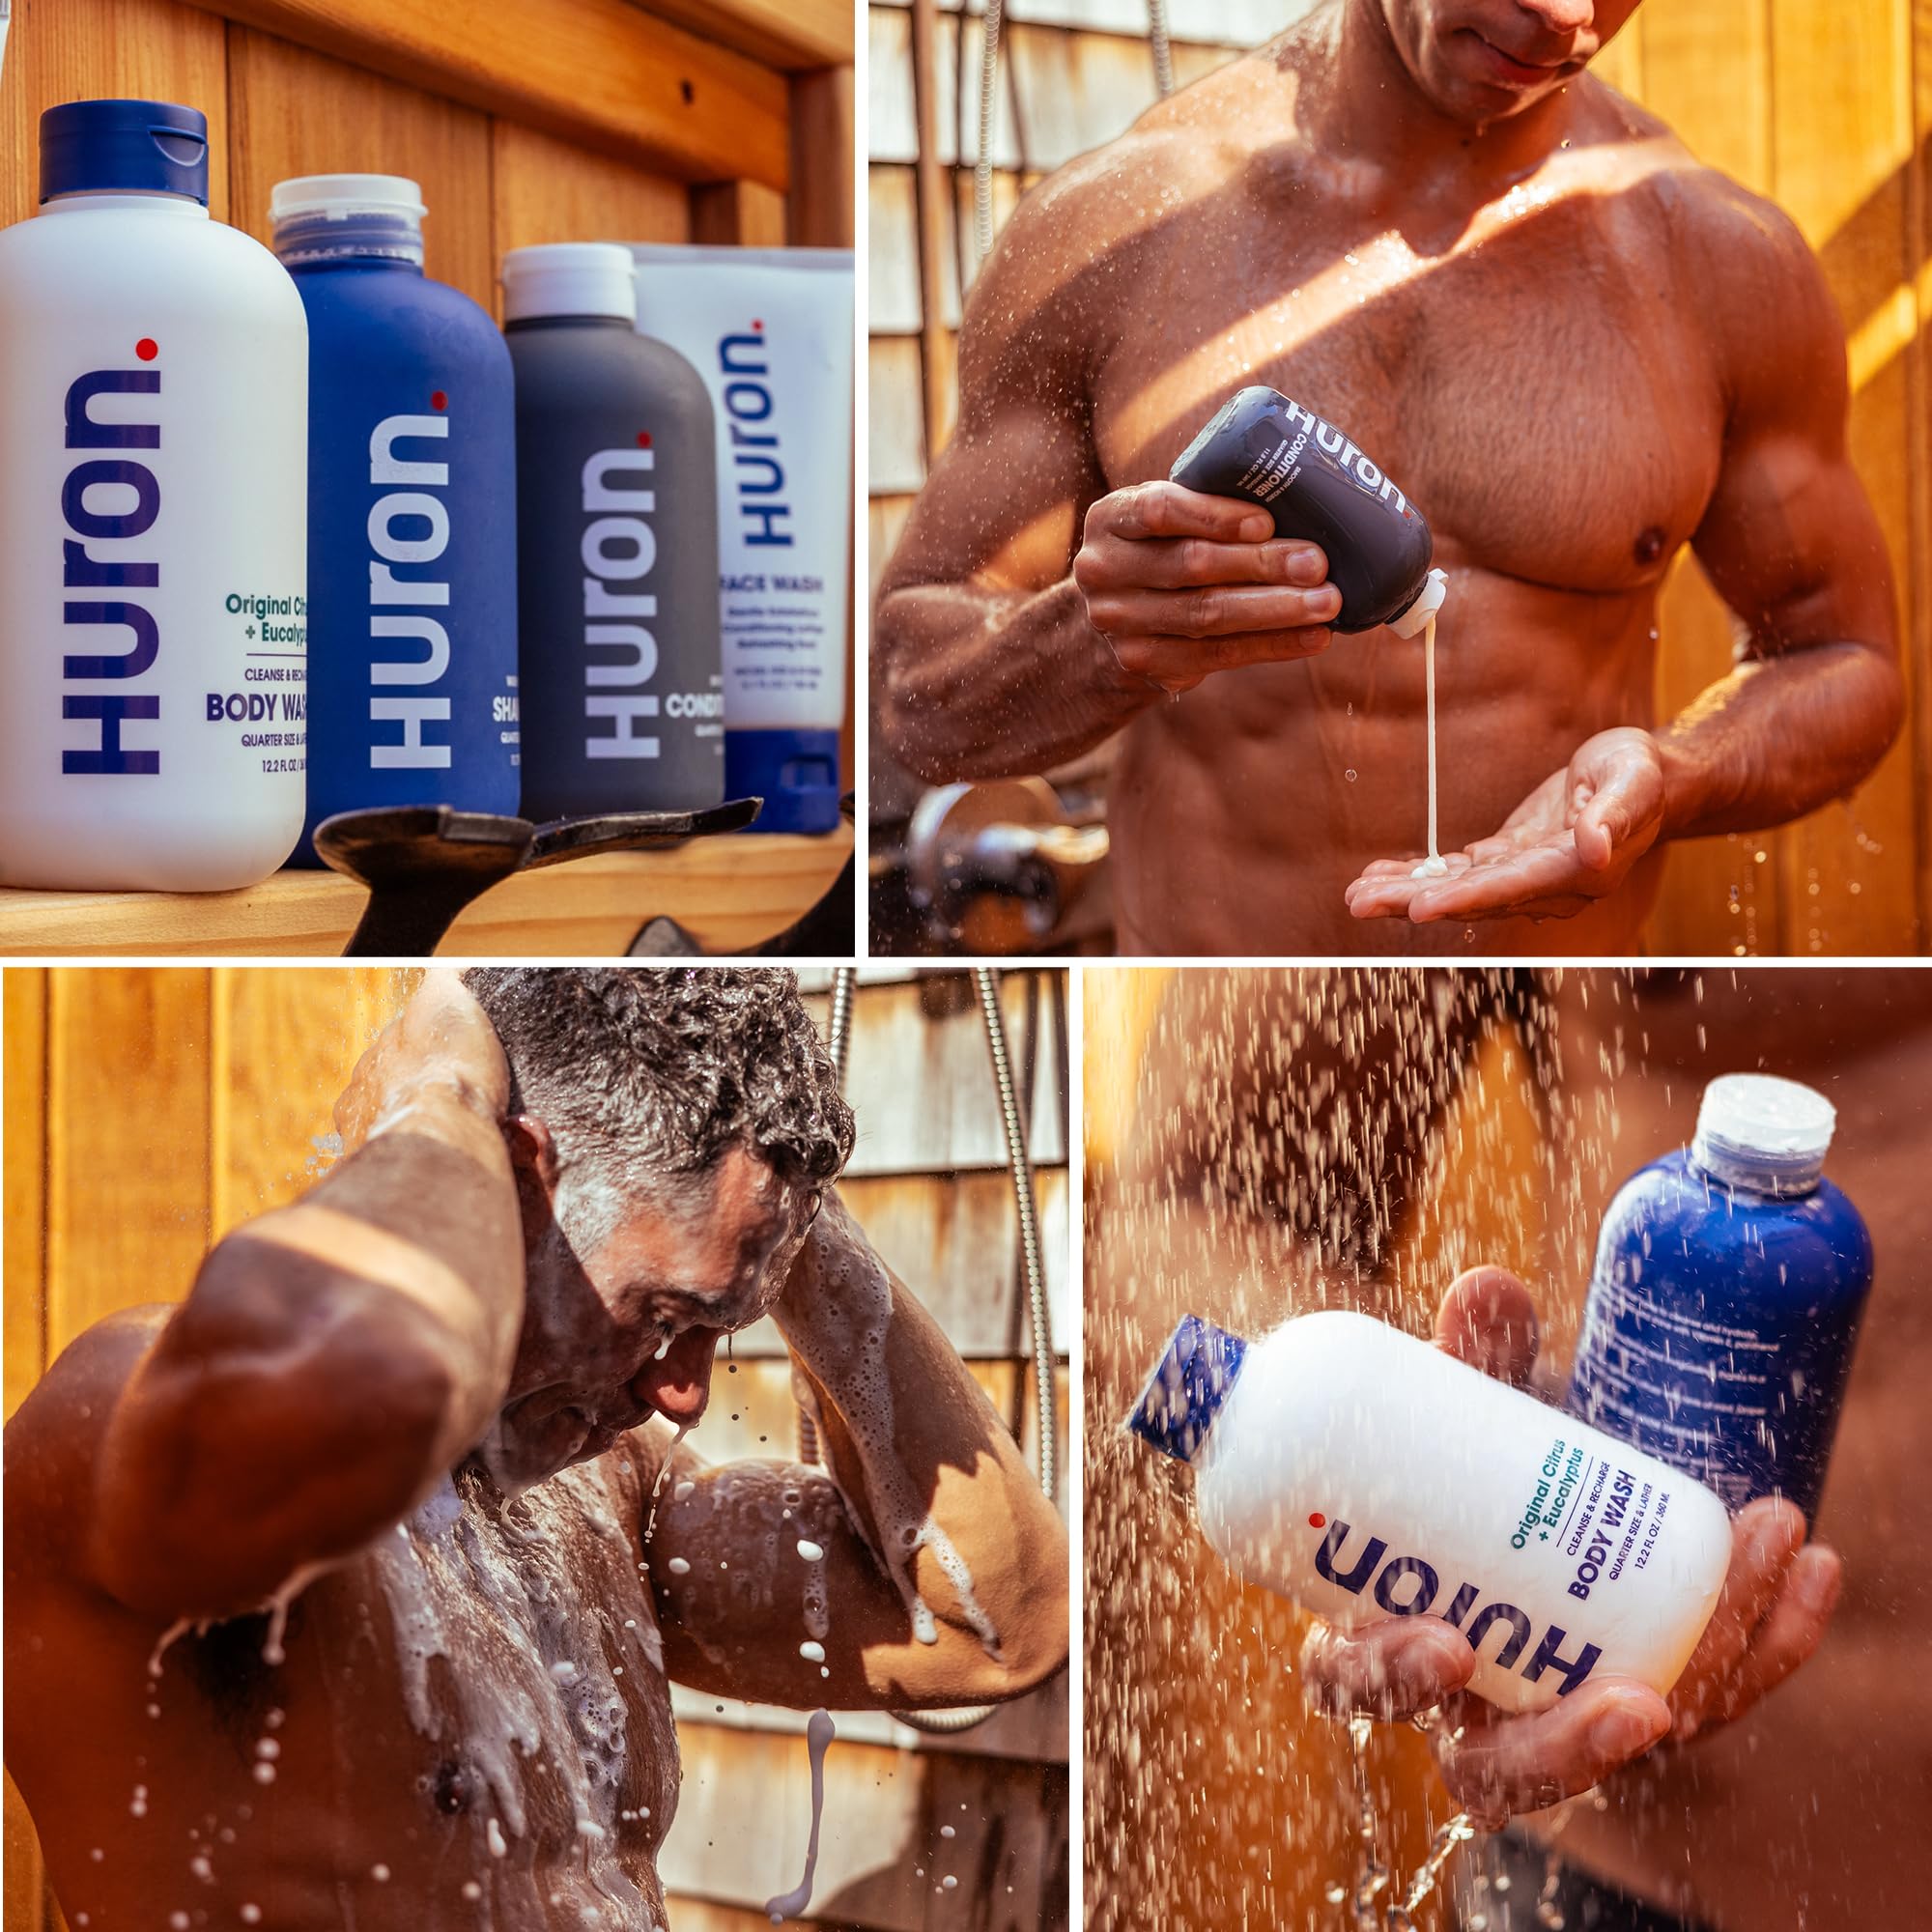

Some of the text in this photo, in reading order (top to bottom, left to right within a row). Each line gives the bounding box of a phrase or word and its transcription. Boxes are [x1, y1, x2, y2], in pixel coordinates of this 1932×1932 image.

[716, 319, 795, 547] Huron.
[1253, 433, 1307, 497] CONDITIONER
[61, 337, 160, 775] Huron.
[367, 390, 451, 769] Huron.
[225, 593, 292, 620] Original
[581, 431, 661, 759] Huron.
[207, 693, 277, 722] BODY
[244, 668, 285, 682] CLEANSE
[242, 733, 284, 748] QUARTER
[262, 759, 280, 774] 12.2
[1510, 1438, 1567, 1549] Original Citrus
[1543, 1448, 1584, 1528] Eucalyptus
[1567, 1512, 1593, 1556] CLEANSE
[1589, 1462, 1610, 1504] RECHARGE
[1567, 1469, 1636, 1601] BODY WASH
[1608, 1536, 1635, 1581] QUARTER
[1628, 1518, 1642, 1537] SIZE
[1642, 1483, 1654, 1510] LATHER
[1634, 1549, 1651, 1570] 12.2
[1644, 1538, 1655, 1550] FL
[1648, 1522, 1661, 1538] OZ
